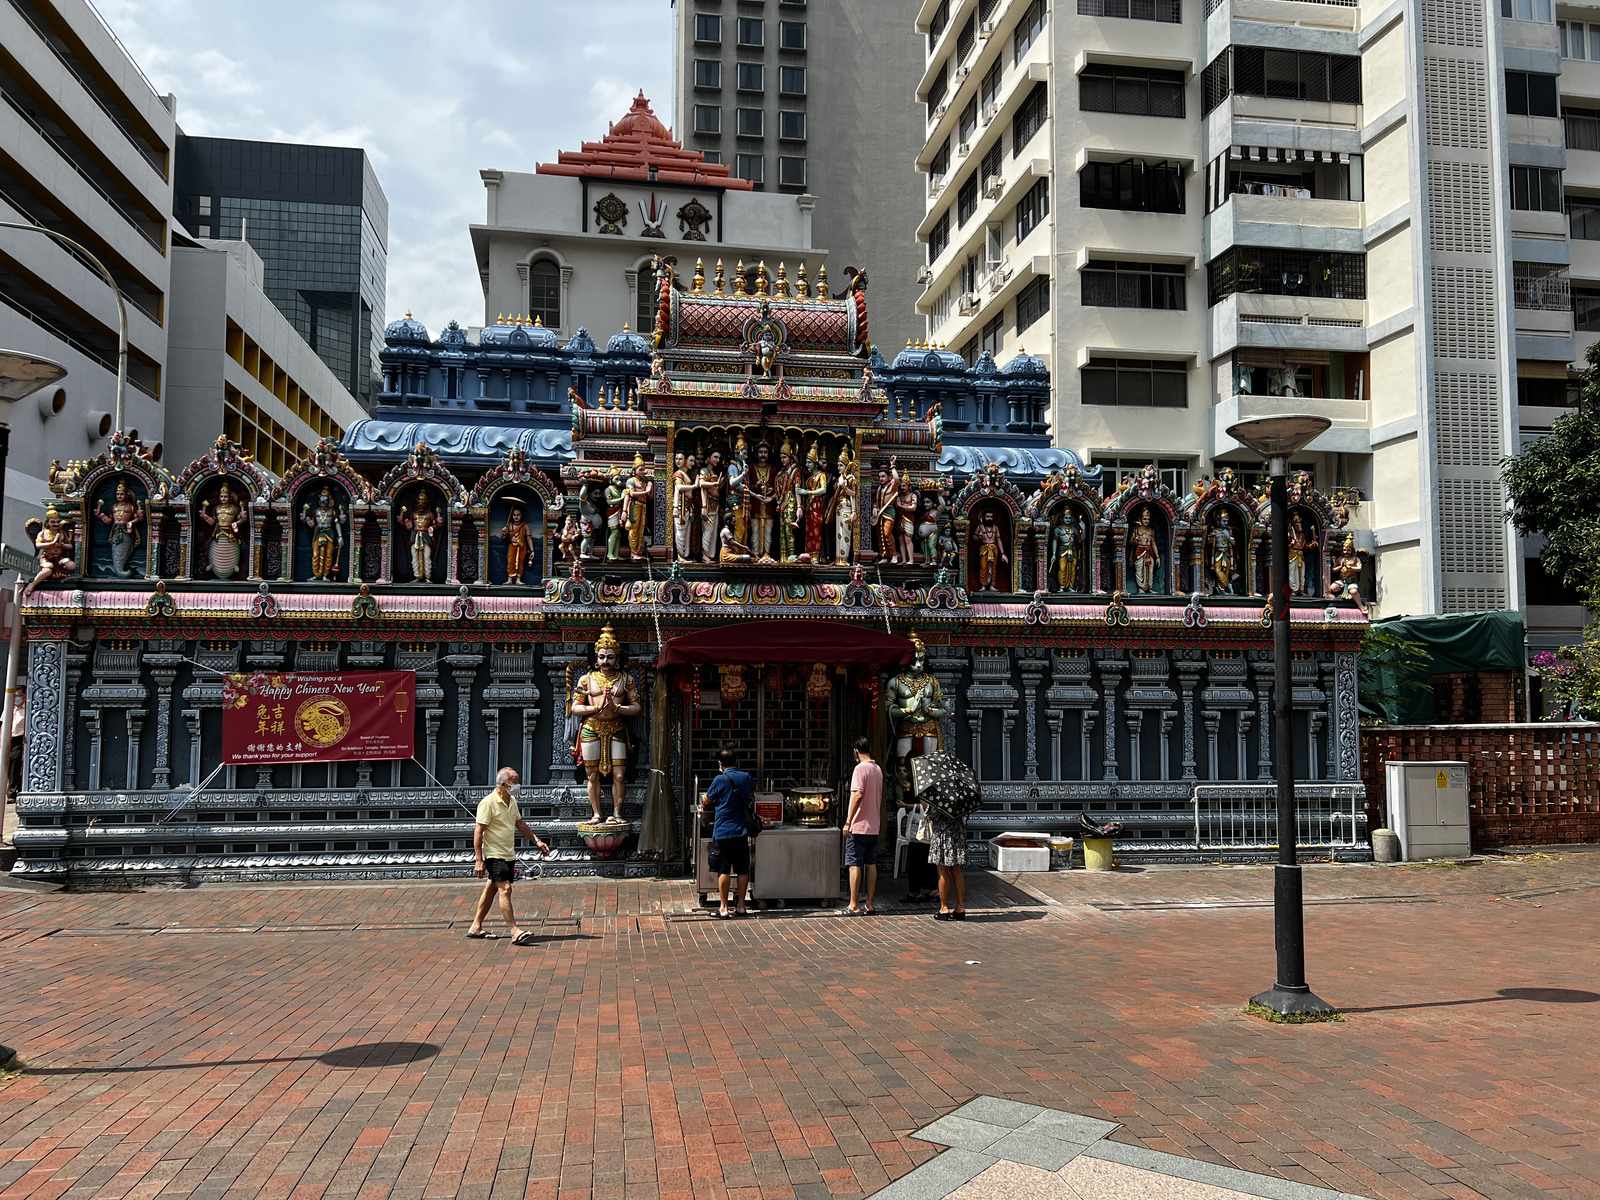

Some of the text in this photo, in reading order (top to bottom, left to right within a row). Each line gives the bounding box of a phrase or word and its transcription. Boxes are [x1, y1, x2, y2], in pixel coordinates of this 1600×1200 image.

[4, 548, 31, 571] Bencoolen
[259, 683, 381, 700] Happy Chinese New Year
